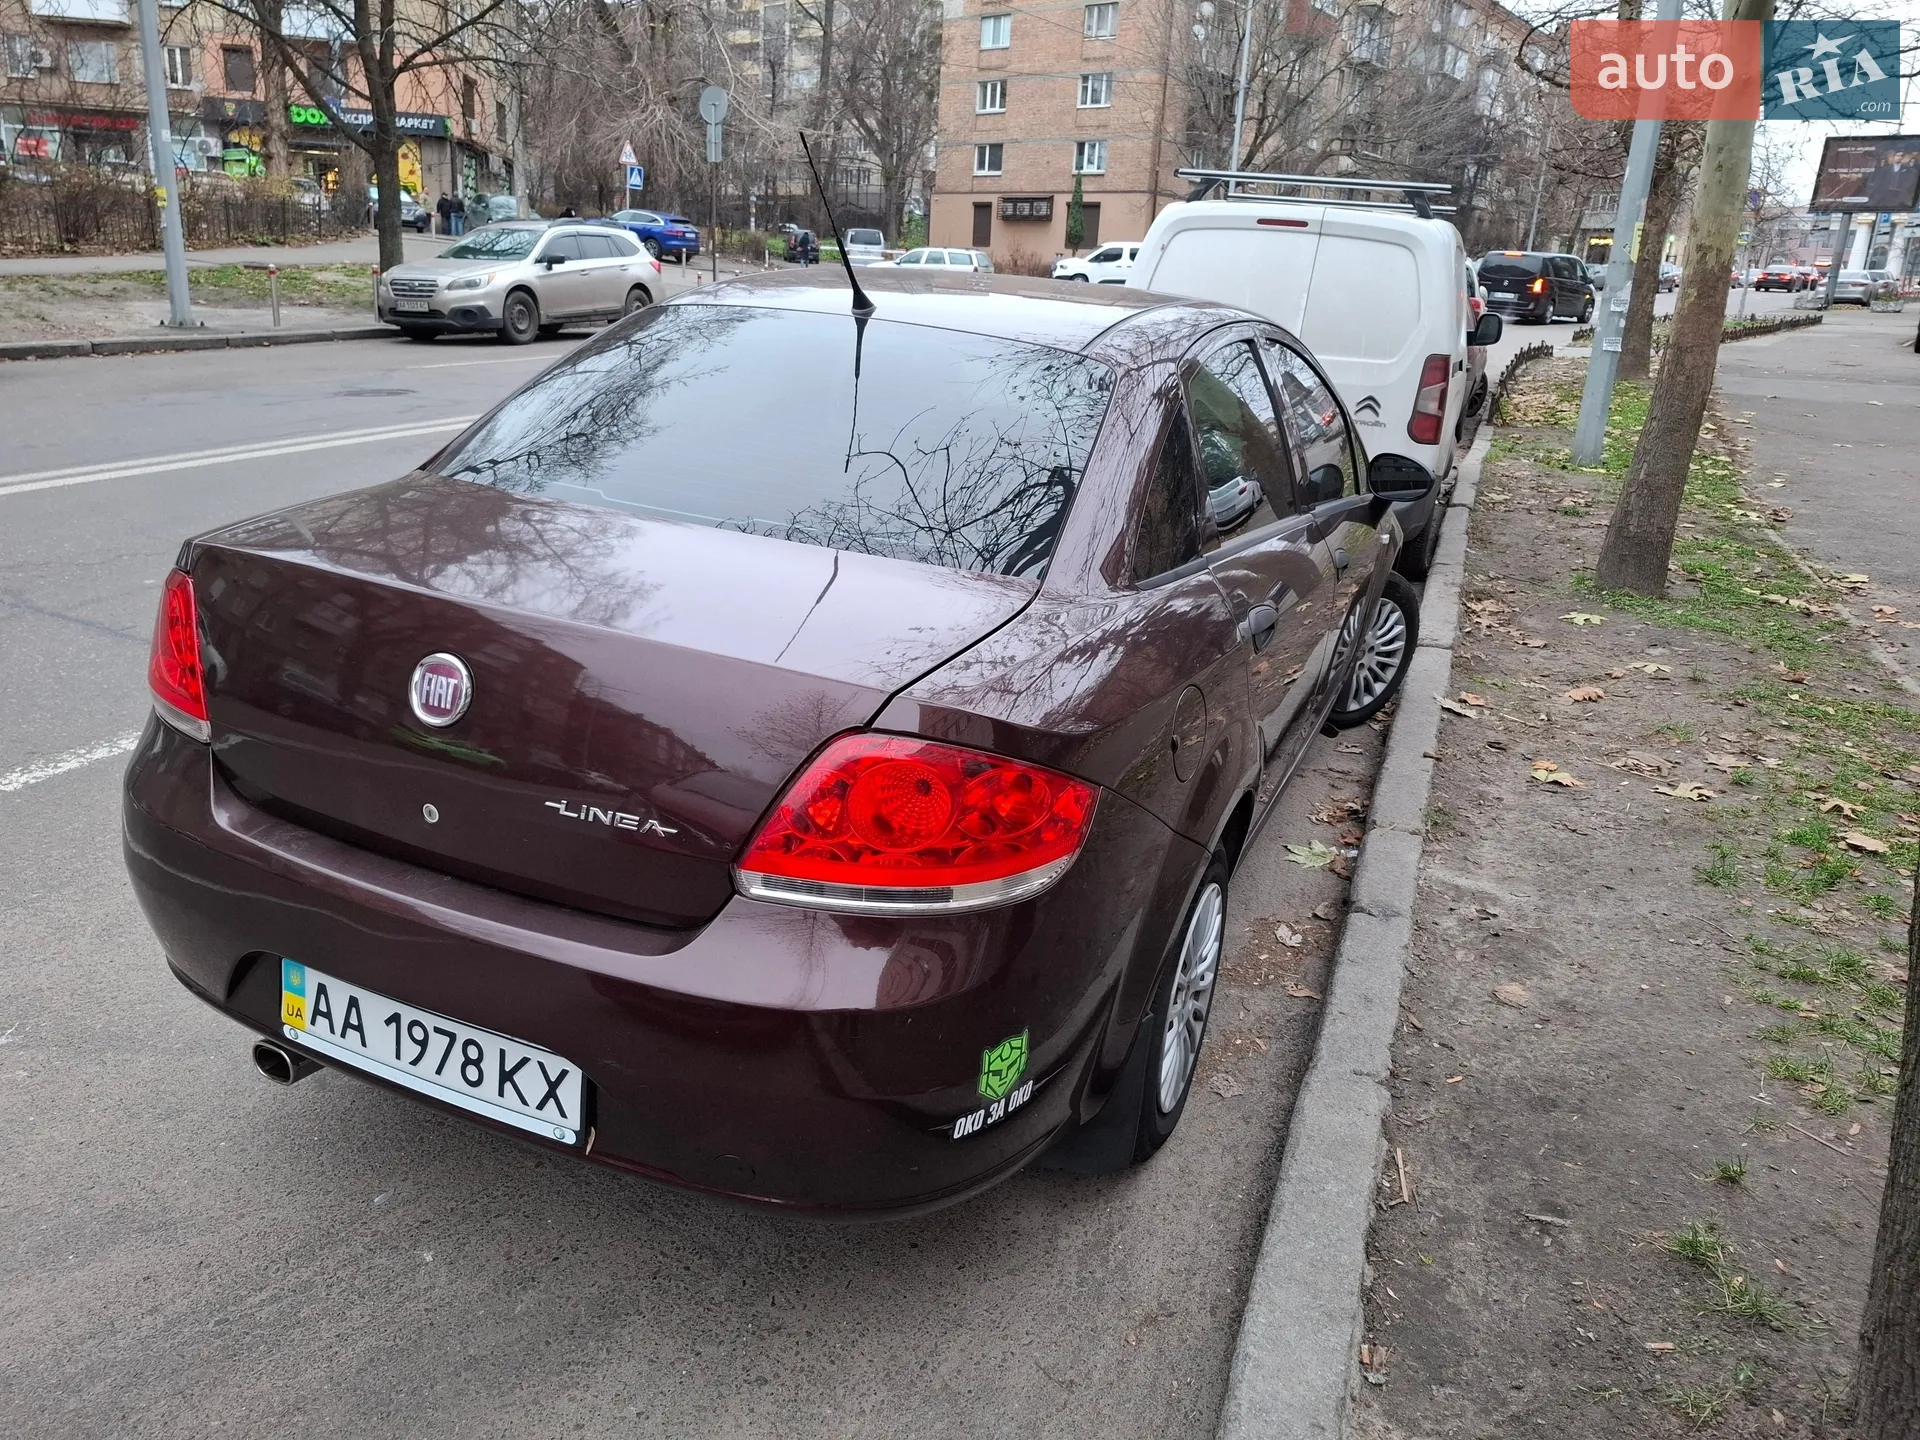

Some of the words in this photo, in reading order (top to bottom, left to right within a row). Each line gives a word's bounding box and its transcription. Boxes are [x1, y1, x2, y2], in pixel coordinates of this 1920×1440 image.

[1353, 419, 1387, 428] TROËN
[421, 672, 458, 710] FIAT
[544, 800, 678, 837] LINEA
[286, 1002, 304, 1021] UA
[310, 981, 367, 1048] AA
[384, 1011, 485, 1088] 1978
[497, 1047, 570, 1119] KX
[953, 1109, 986, 1139] ОКО
[987, 1098, 1006, 1124] ЗА
[1008, 1080, 1034, 1112] ОКО
